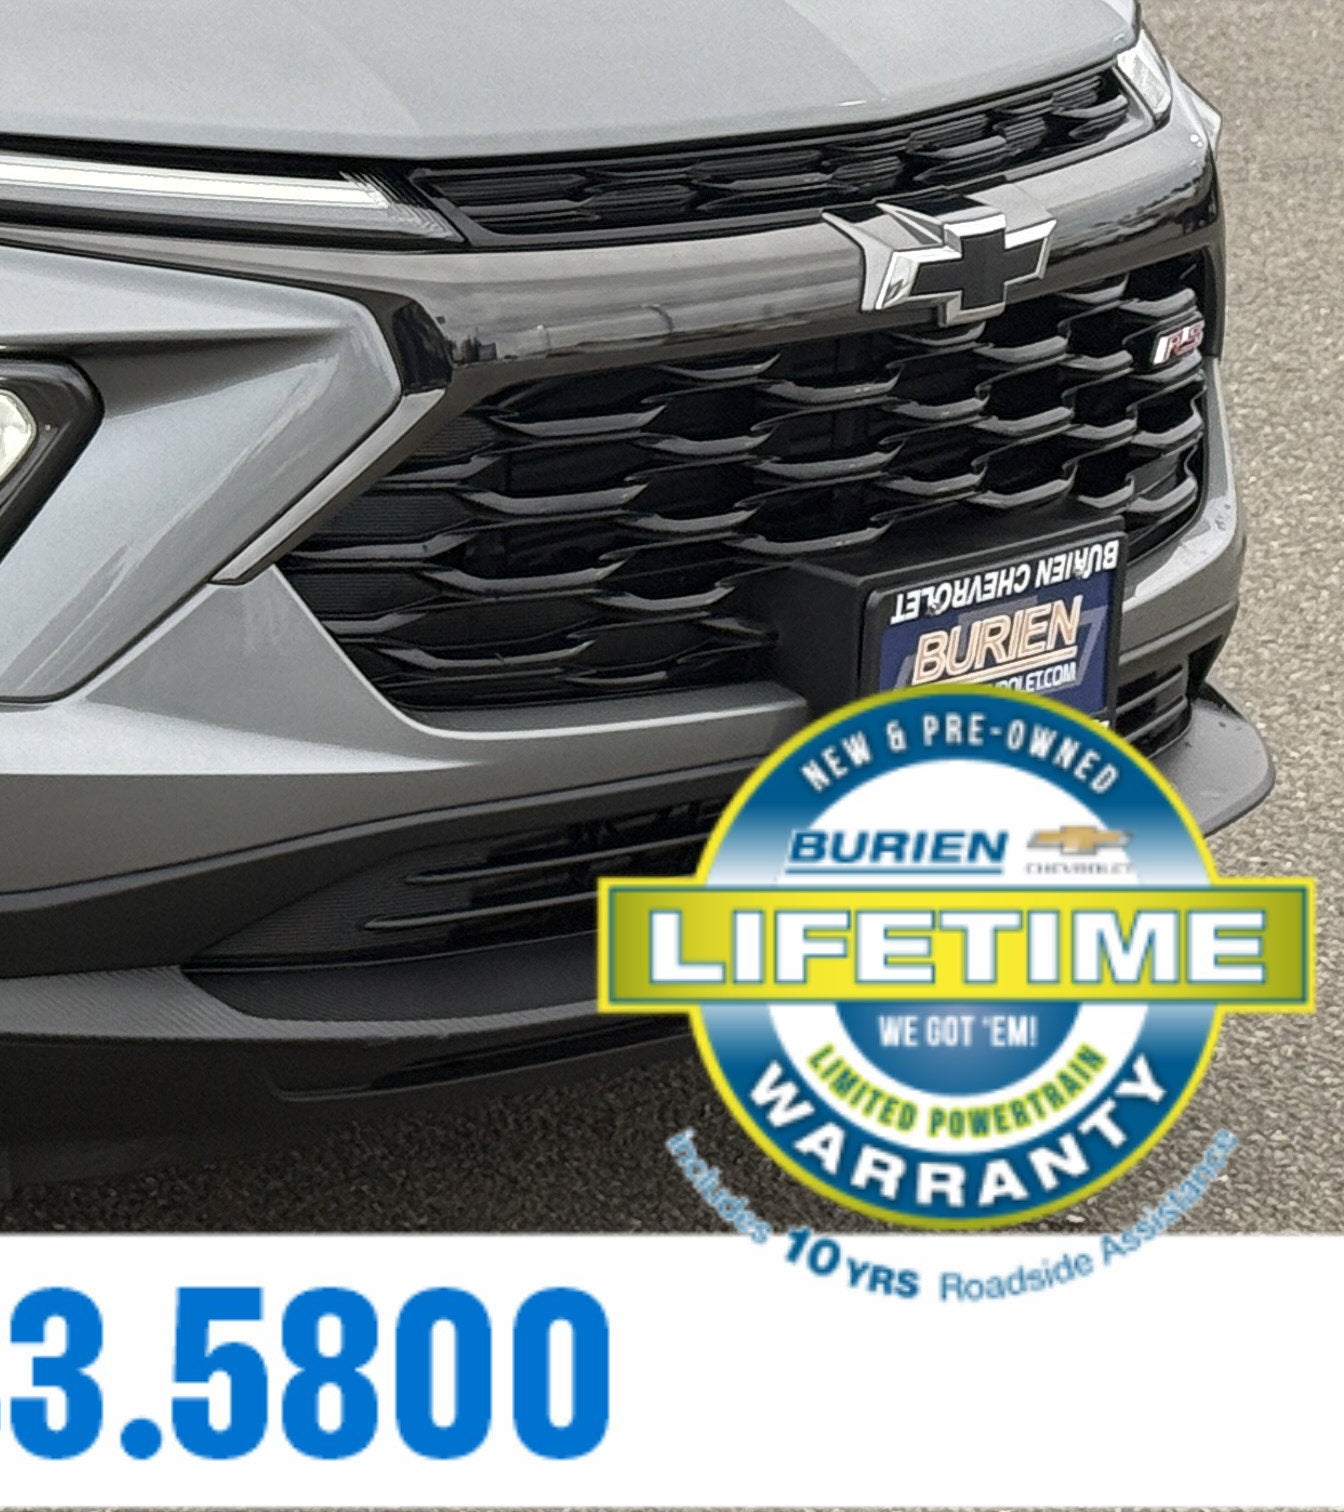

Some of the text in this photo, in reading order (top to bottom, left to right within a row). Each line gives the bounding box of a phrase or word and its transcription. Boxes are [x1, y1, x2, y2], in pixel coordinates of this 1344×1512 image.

[890, 539, 1119, 624] BURIEN CHEVROLET
[912, 594, 1083, 685] BURIEN
